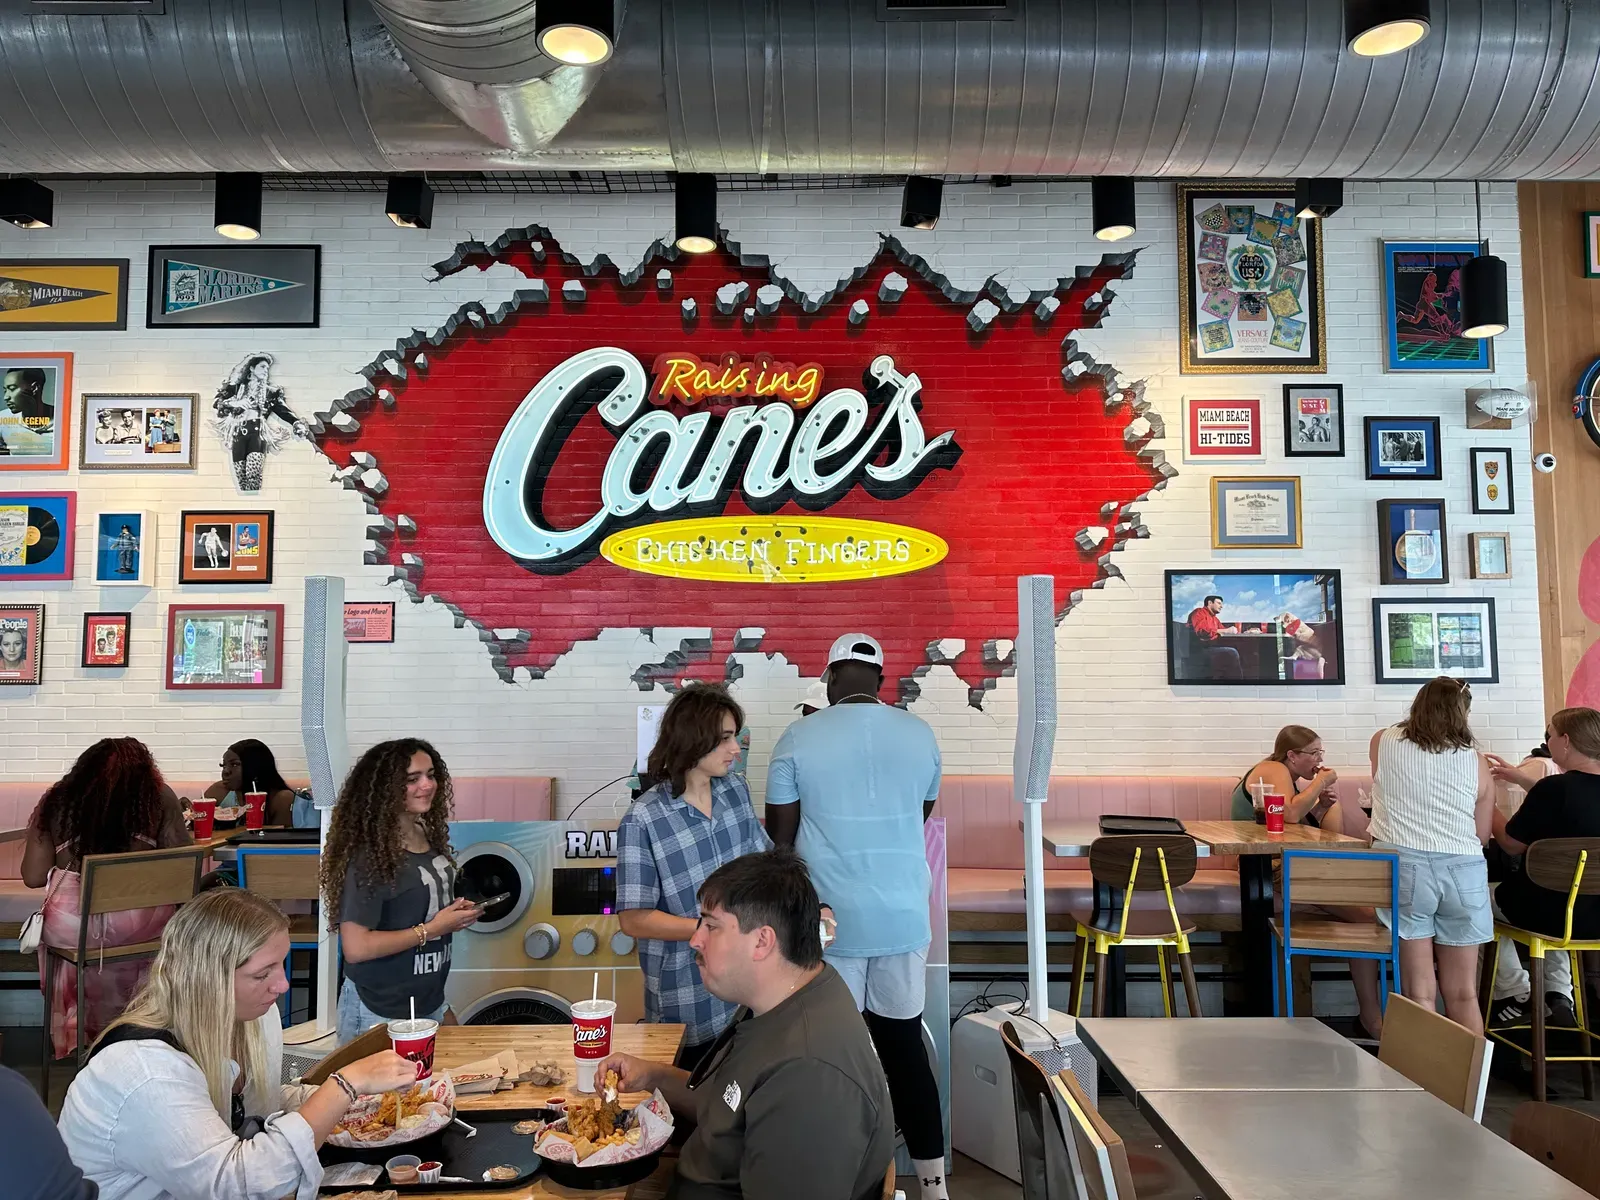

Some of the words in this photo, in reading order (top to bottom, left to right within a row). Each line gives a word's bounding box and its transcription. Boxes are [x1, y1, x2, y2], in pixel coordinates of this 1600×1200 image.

[199, 267, 264, 286] FLORIDA
[32, 287, 61, 301] MIAMI
[62, 287, 83, 298] BEACH
[175, 294, 196, 302] 1993
[198, 284, 264, 304] MARLINS
[656, 356, 820, 404] Raising
[0, 417, 19, 425] JOHN
[20, 416, 50, 426] LEGEND
[1199, 410, 1224, 422] MIAMI
[1225, 410, 1250, 422] BEACH
[1200, 432, 1250, 445] HI-TIDES
[482, 346, 956, 560] Cane's
[637, 537, 770, 563] CHICKEN
[784, 538, 910, 564] FINGERS
[347, 608, 360, 616] Logo
[0, 618, 28, 630] People
[413, 951, 442, 975] NEW
